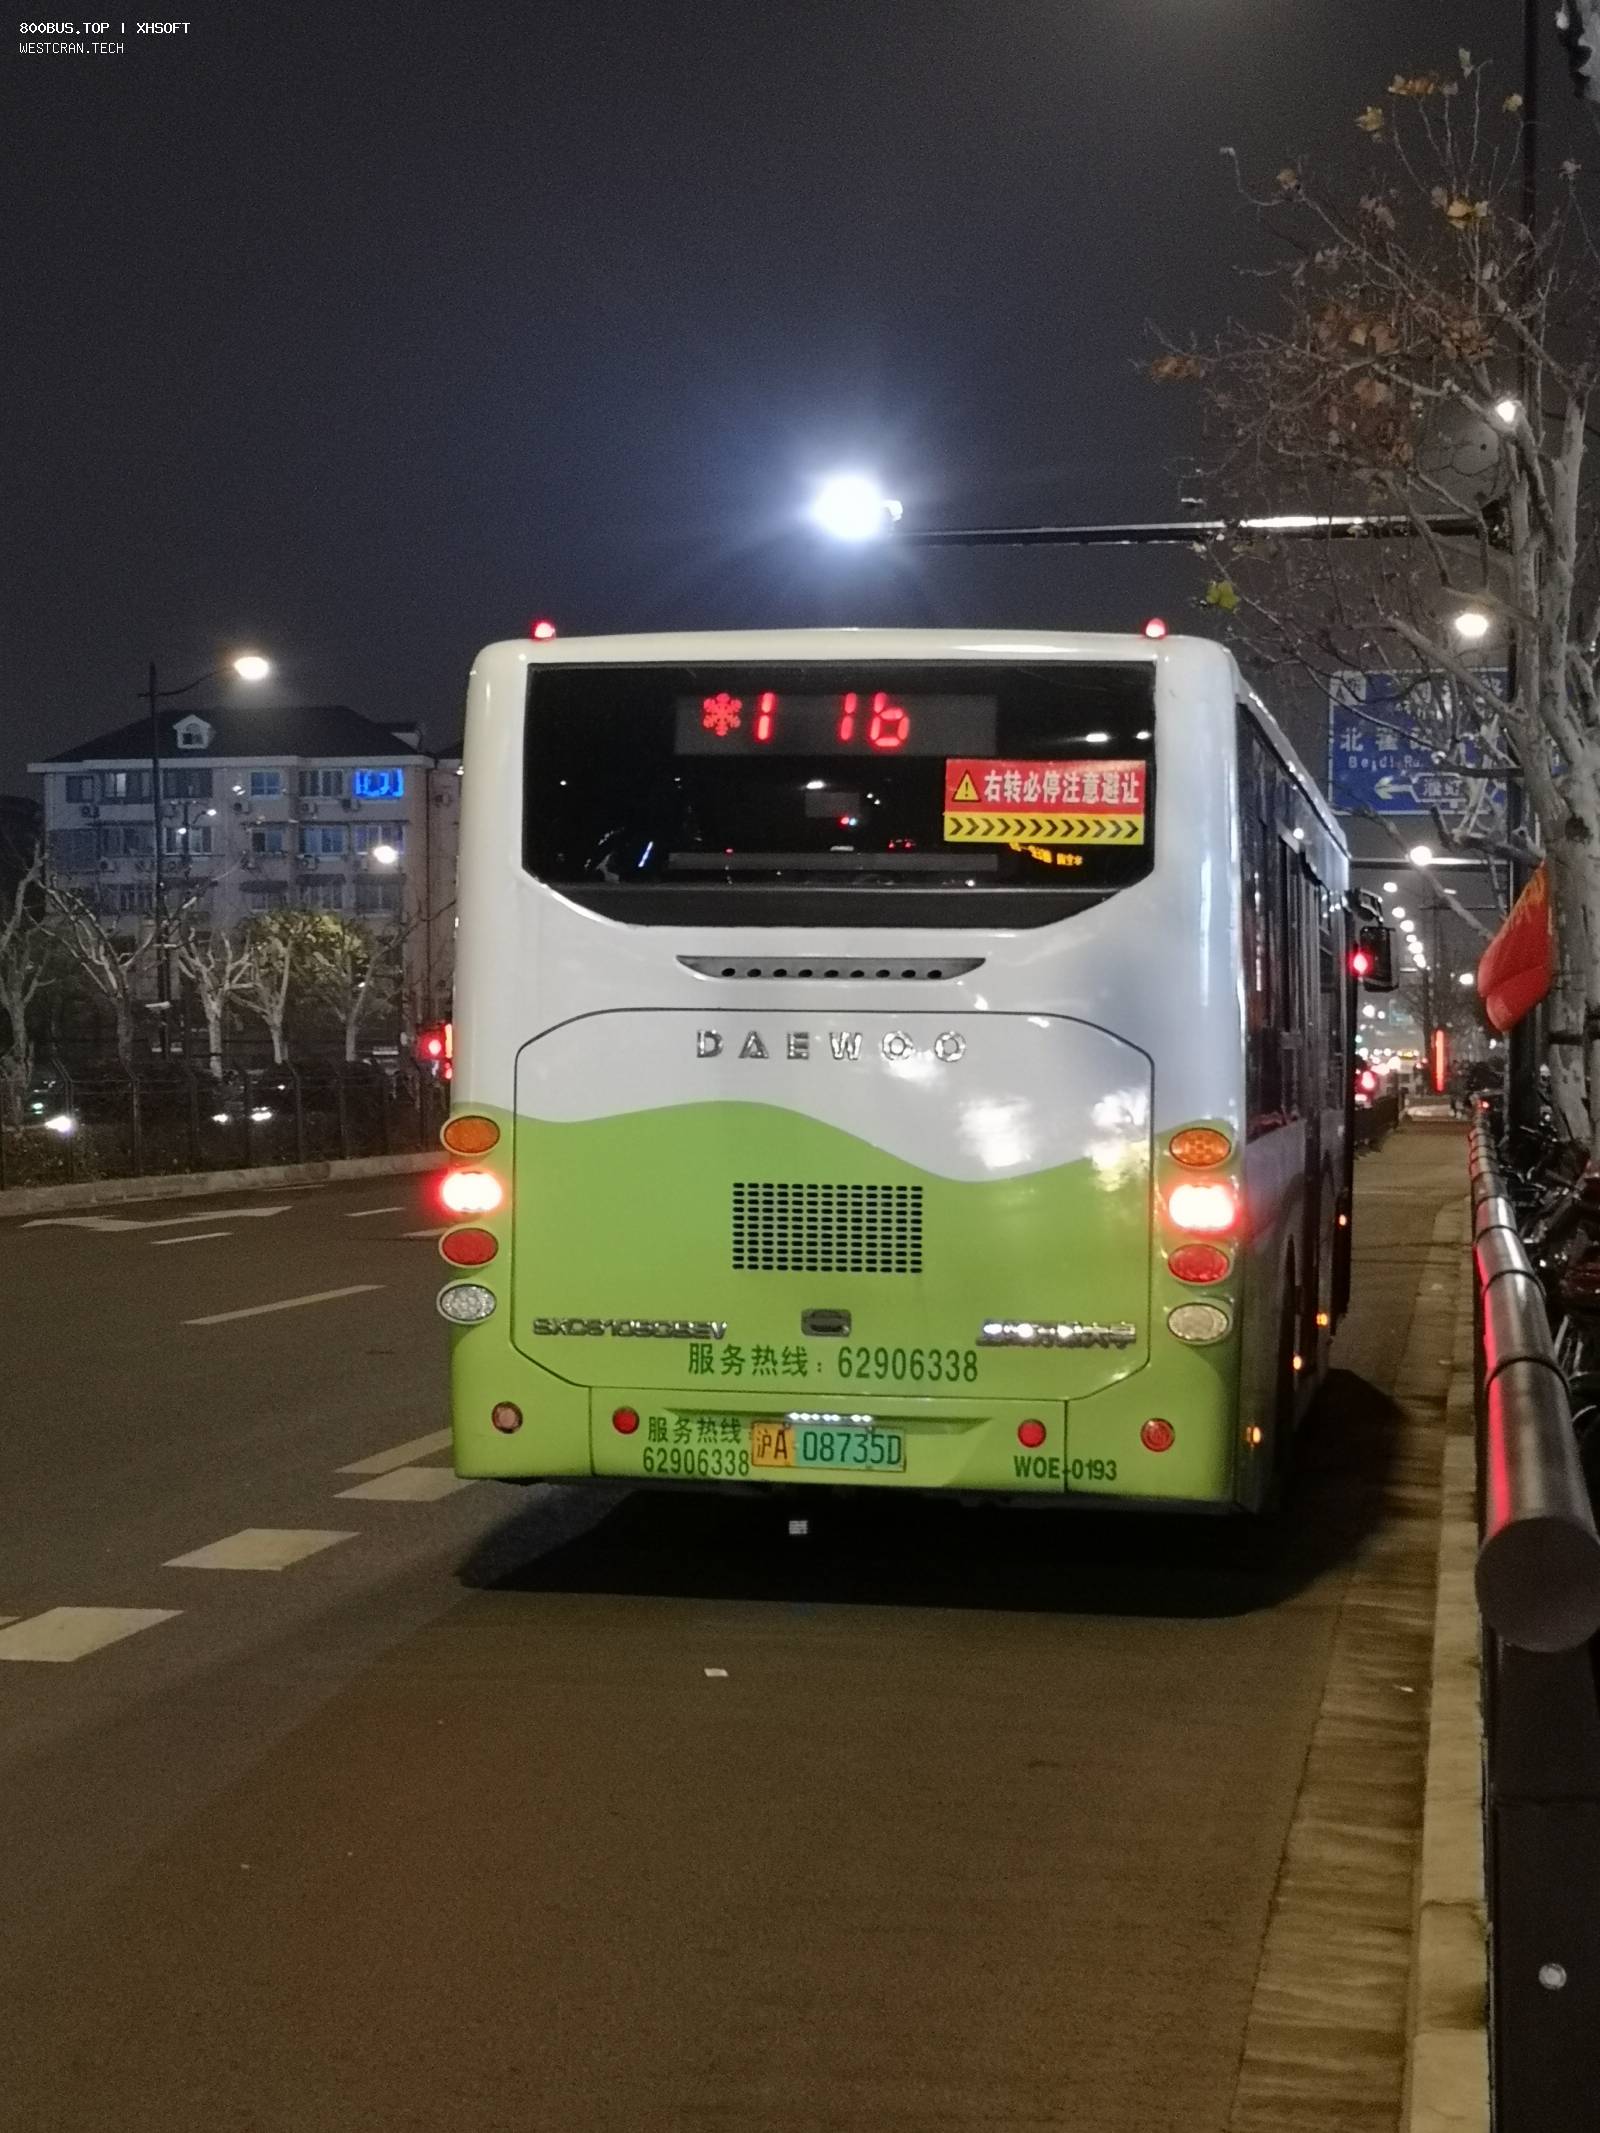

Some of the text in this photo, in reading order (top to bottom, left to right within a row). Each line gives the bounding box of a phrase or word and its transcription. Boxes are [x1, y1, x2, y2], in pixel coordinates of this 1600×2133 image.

[984, 769, 1140, 804] 右转必停注意避让
[697, 1029, 966, 1062] DAEWOO
[837, 1346, 979, 1382] 62906338
[648, 1416, 742, 1444] 服务热线
[643, 1446, 749, 1477] 62906338
[1013, 1455, 1117, 1481] WOE-0193
